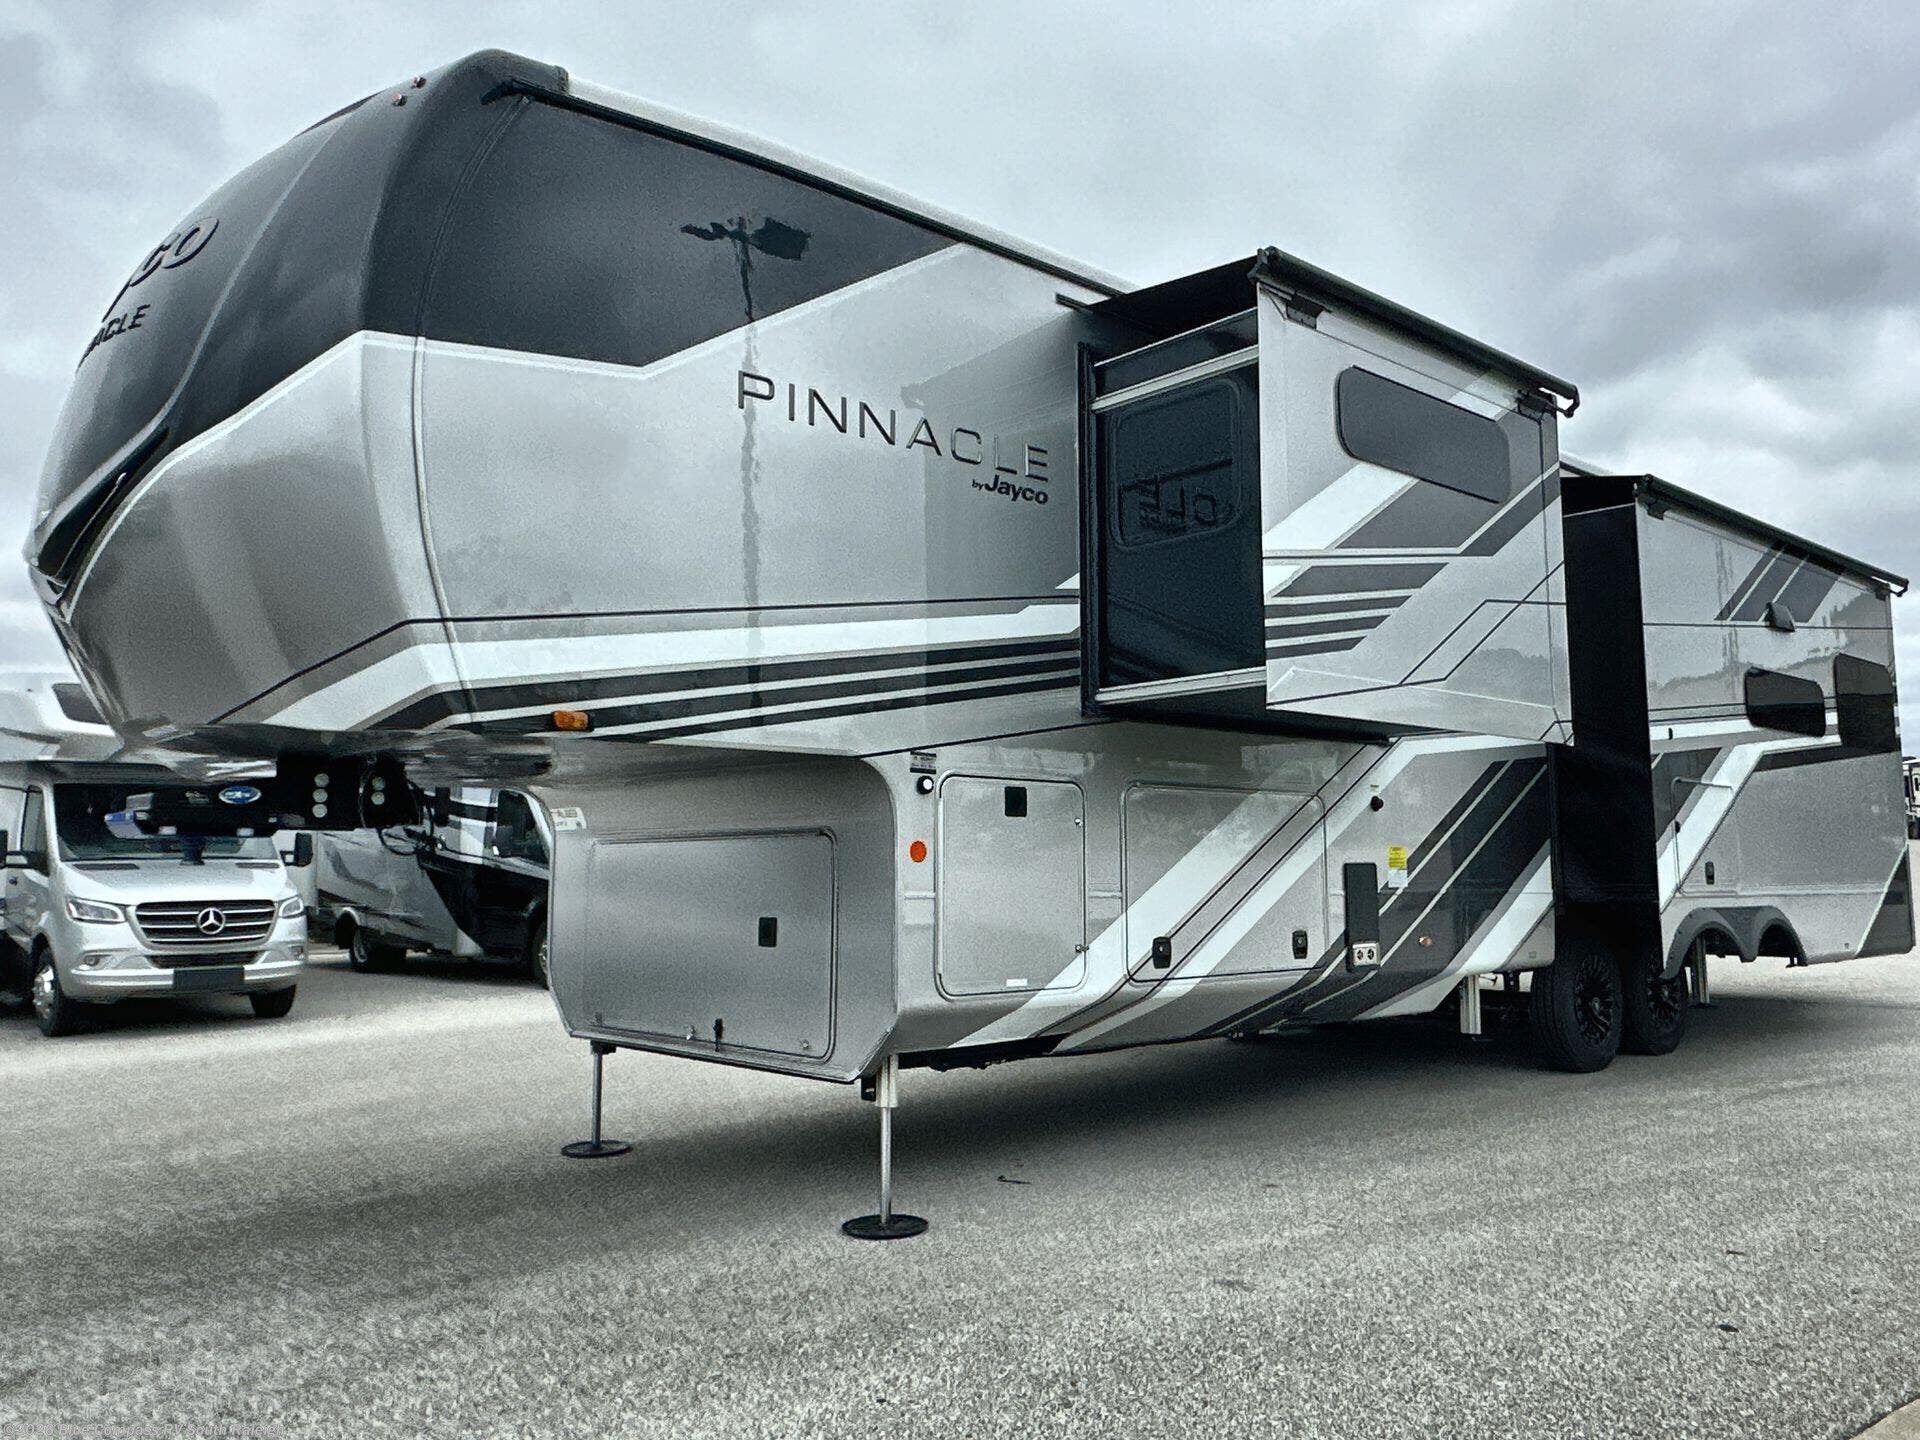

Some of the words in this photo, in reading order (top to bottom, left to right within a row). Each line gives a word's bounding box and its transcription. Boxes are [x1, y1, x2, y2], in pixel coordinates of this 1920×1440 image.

[738, 369, 1049, 483] PINNACLE
[972, 479, 984, 491] by
[984, 475, 1048, 504] Jayco
